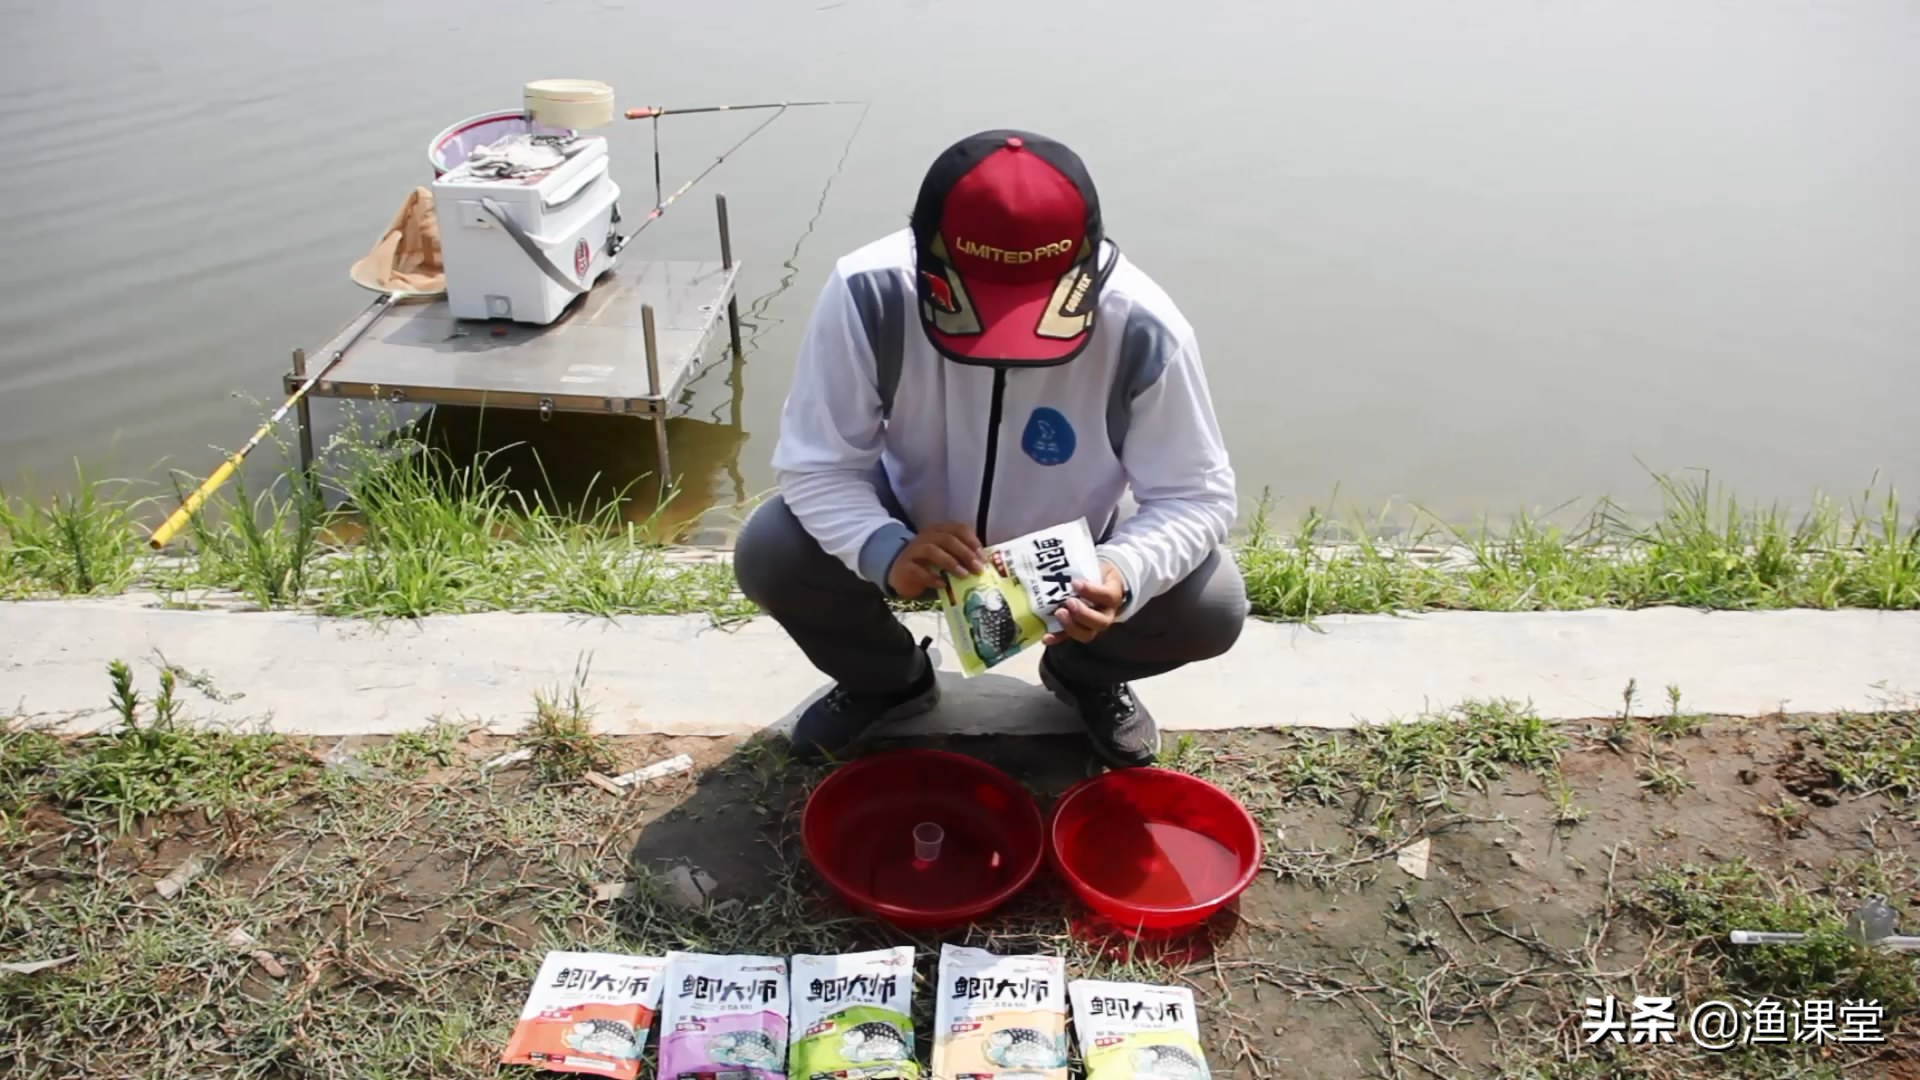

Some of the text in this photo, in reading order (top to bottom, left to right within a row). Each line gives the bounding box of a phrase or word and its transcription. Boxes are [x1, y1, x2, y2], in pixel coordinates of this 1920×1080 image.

[955, 236, 1073, 264] LIMITED PRO
[551, 968, 650, 997] 鲫大师
[678, 974, 778, 1005] 鲫大师
[806, 973, 897, 1004] 鲫大师
[953, 976, 1048, 1003] 鲫大师
[1089, 996, 1184, 1024] 鲫大师
